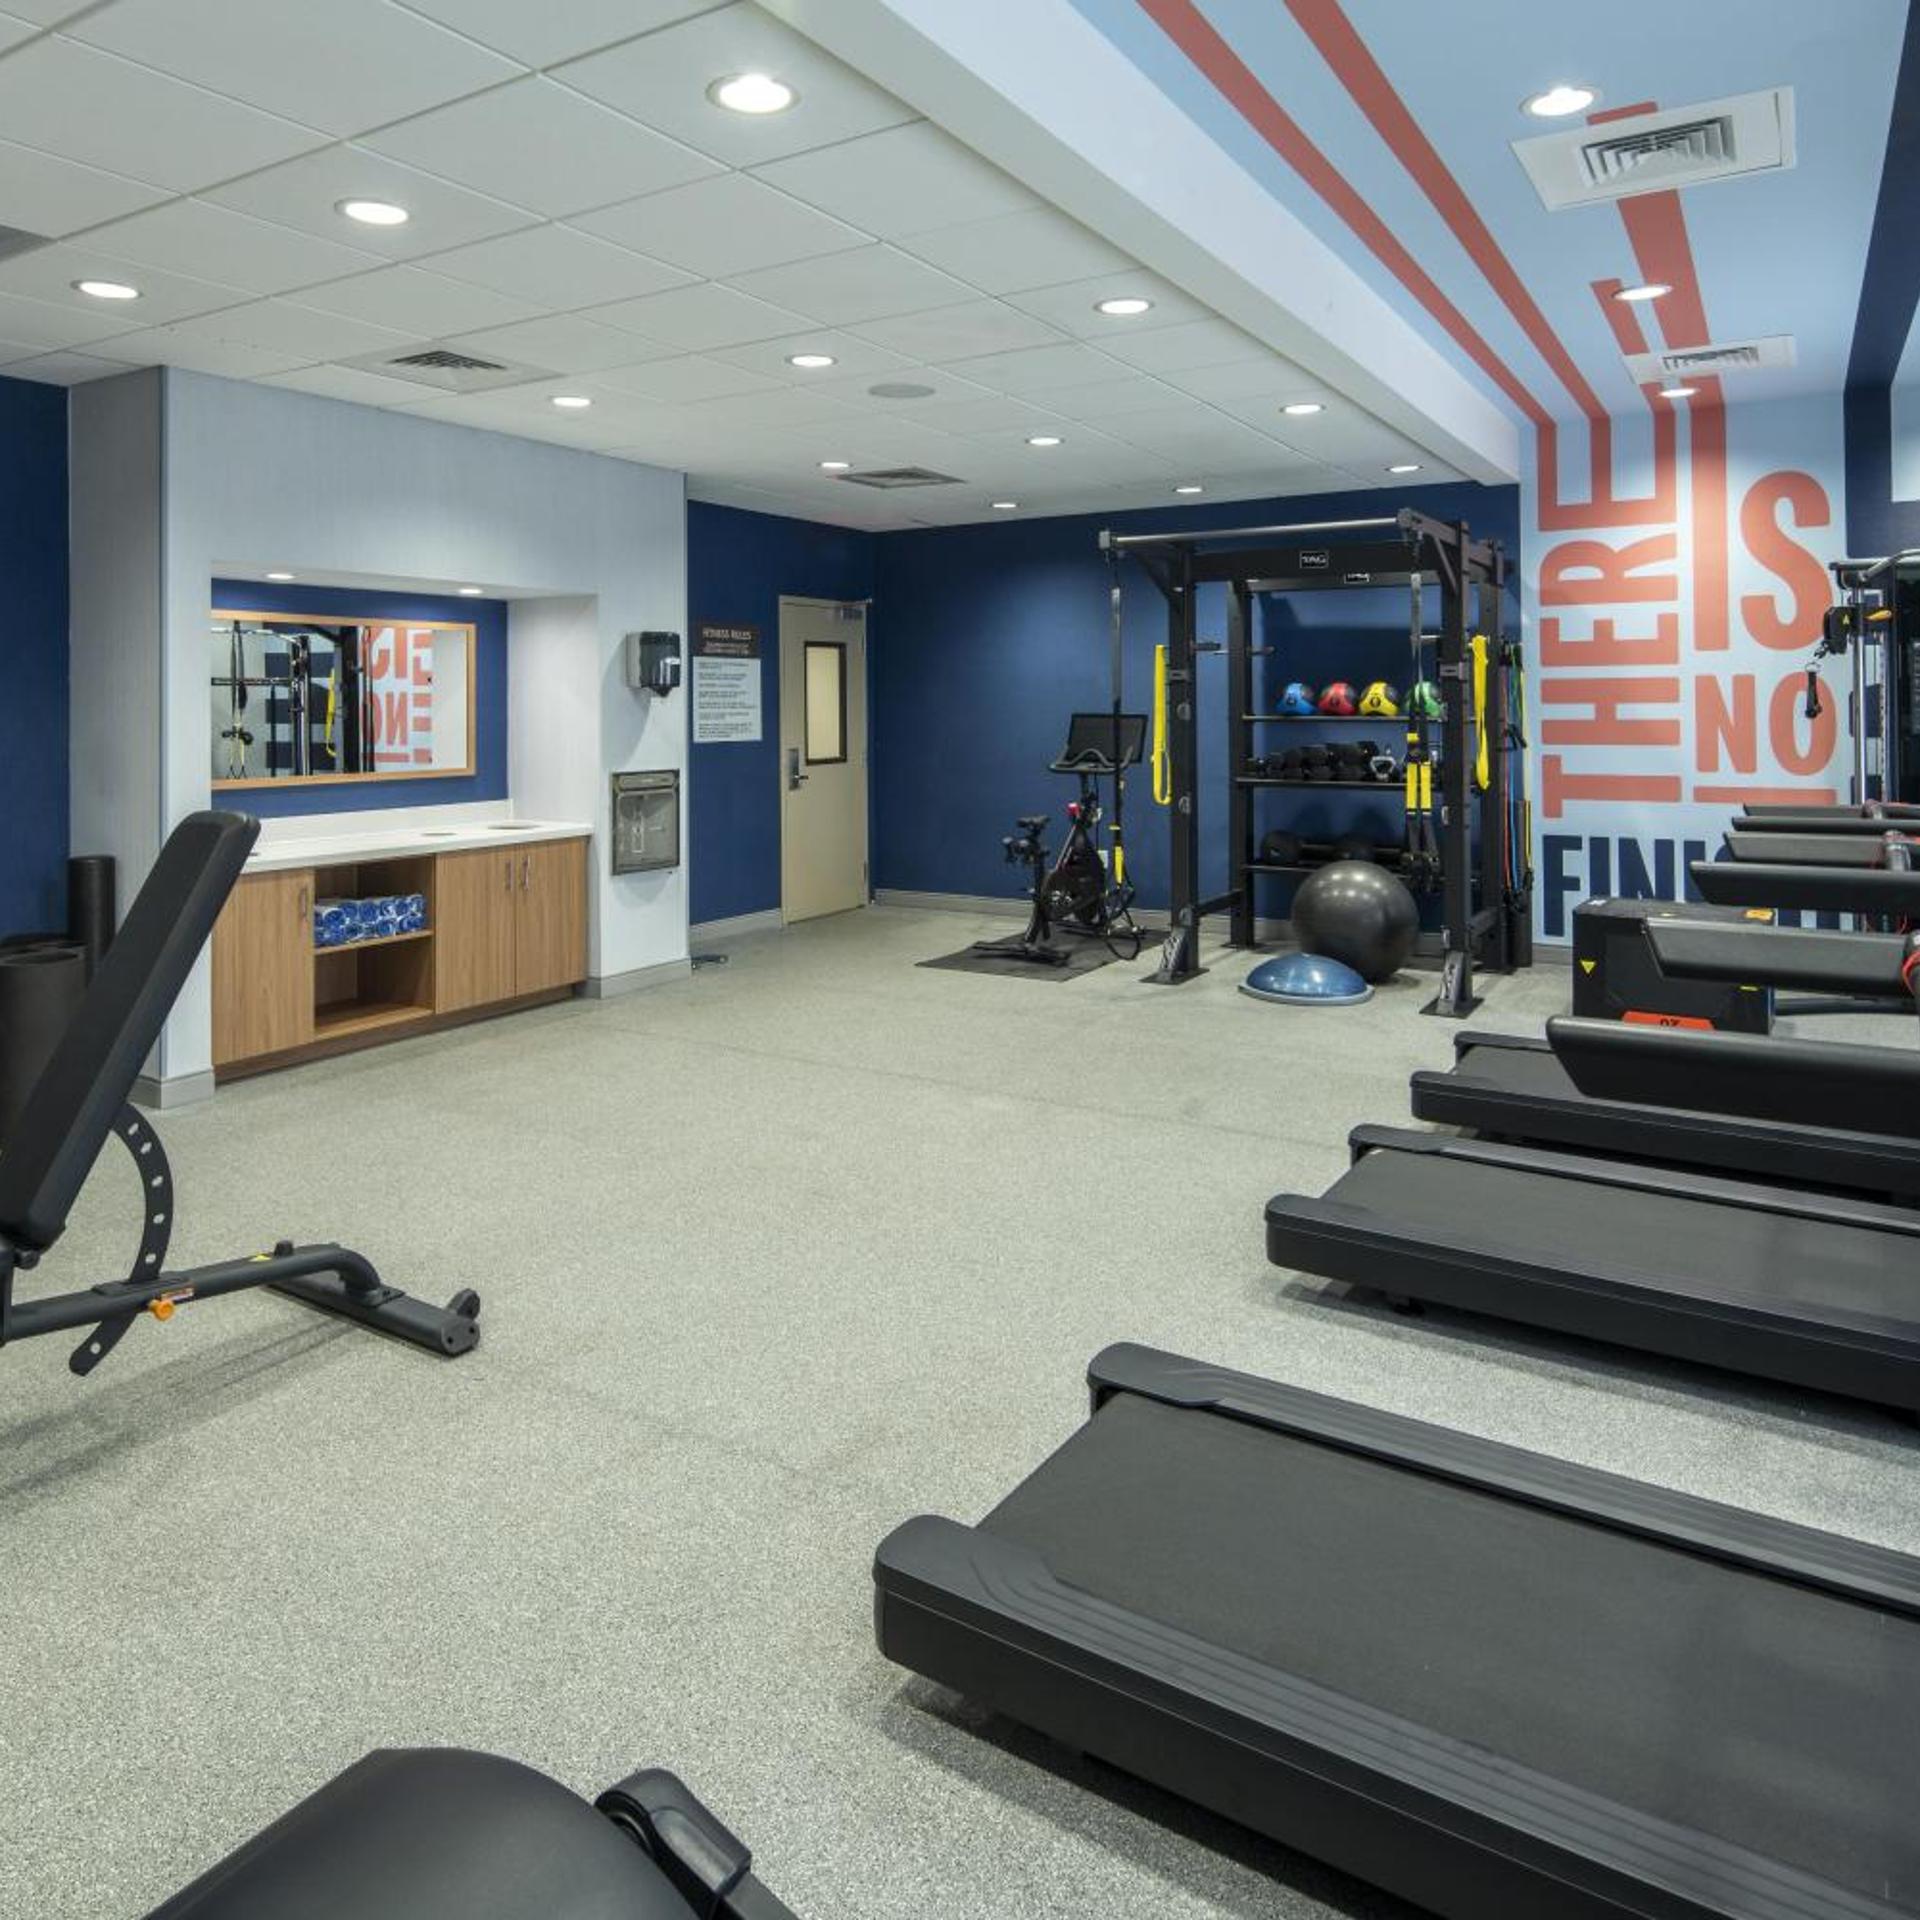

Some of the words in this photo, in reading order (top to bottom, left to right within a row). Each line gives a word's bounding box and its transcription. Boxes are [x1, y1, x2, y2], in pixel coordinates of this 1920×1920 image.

[1536, 416, 1682, 818] THERE
[1690, 400, 1834, 652] IS
[1694, 672, 1838, 777] NO
